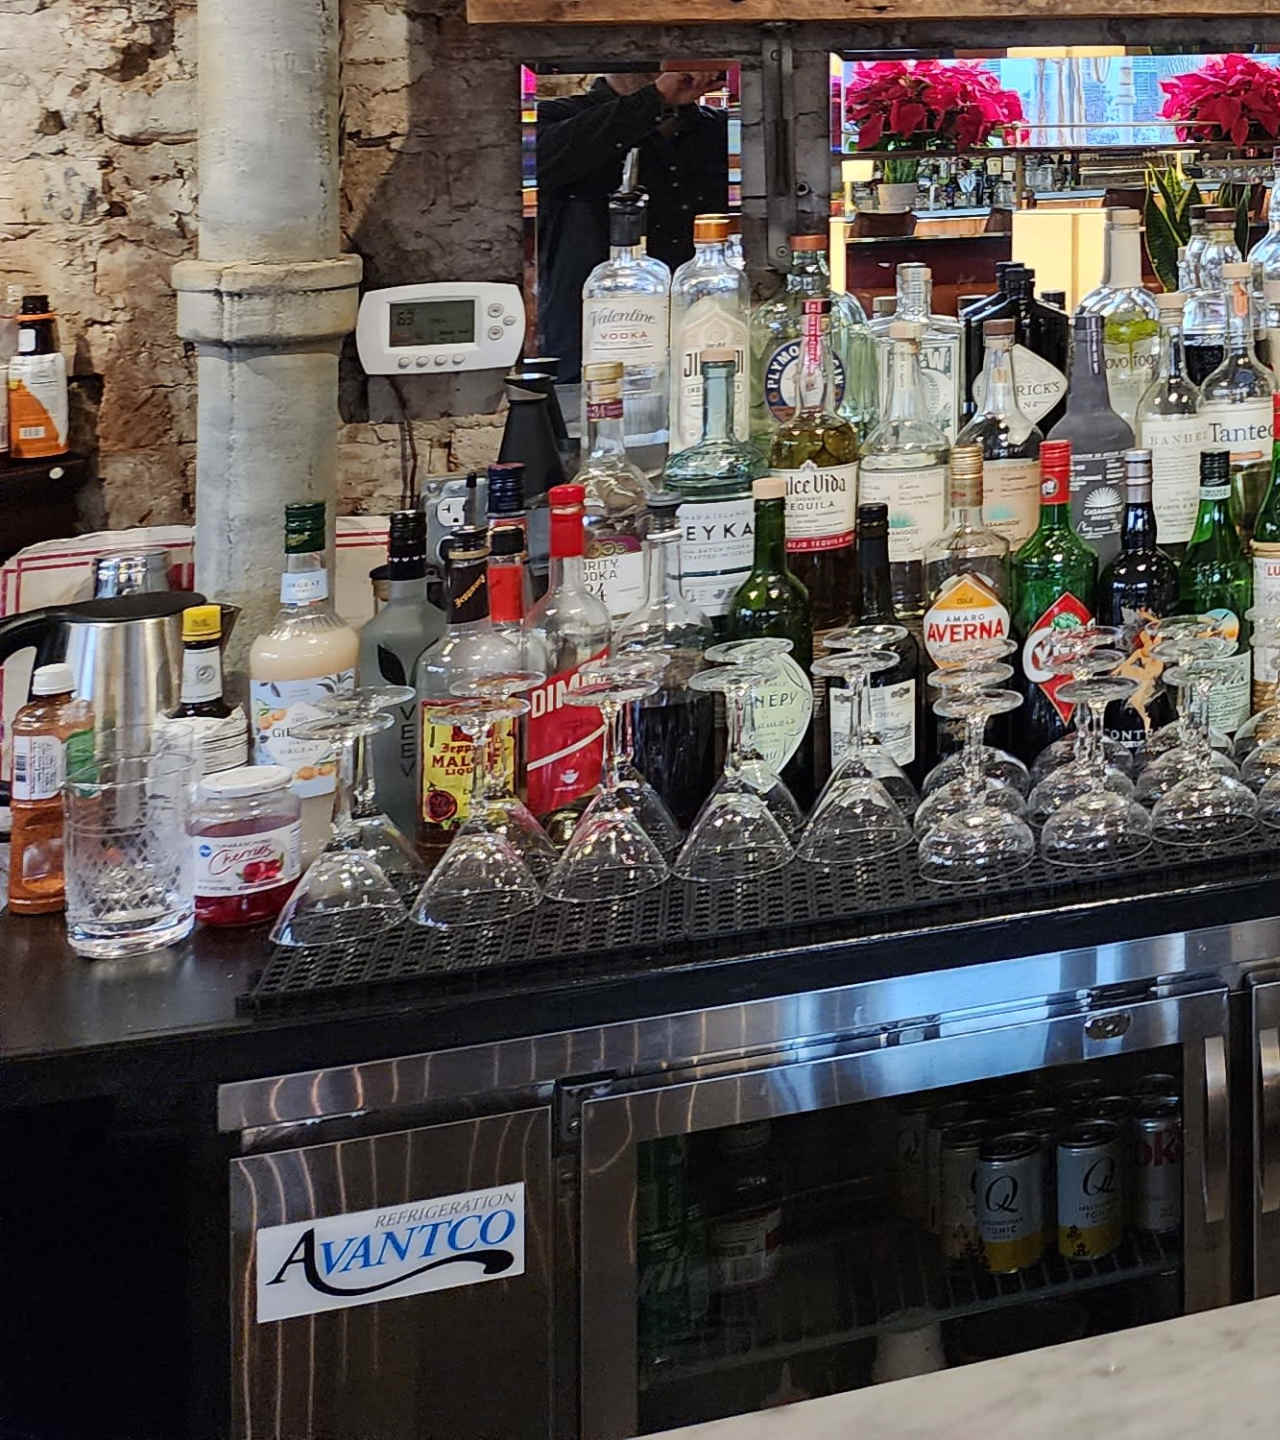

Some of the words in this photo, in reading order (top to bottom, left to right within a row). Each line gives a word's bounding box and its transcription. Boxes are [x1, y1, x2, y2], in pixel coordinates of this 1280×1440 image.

[590, 307, 657, 327] Valentine
[600, 331, 648, 341] VODKA
[686, 521, 754, 542] EYKA
[584, 559, 618, 571] RITY
[946, 613, 985, 622] AMARO
[927, 618, 1004, 643] AVERNA
[985, 1175, 1019, 1212] Q
[374, 1191, 518, 1229] REFRIGERATION
[265, 1208, 516, 1296] AVANTCO
